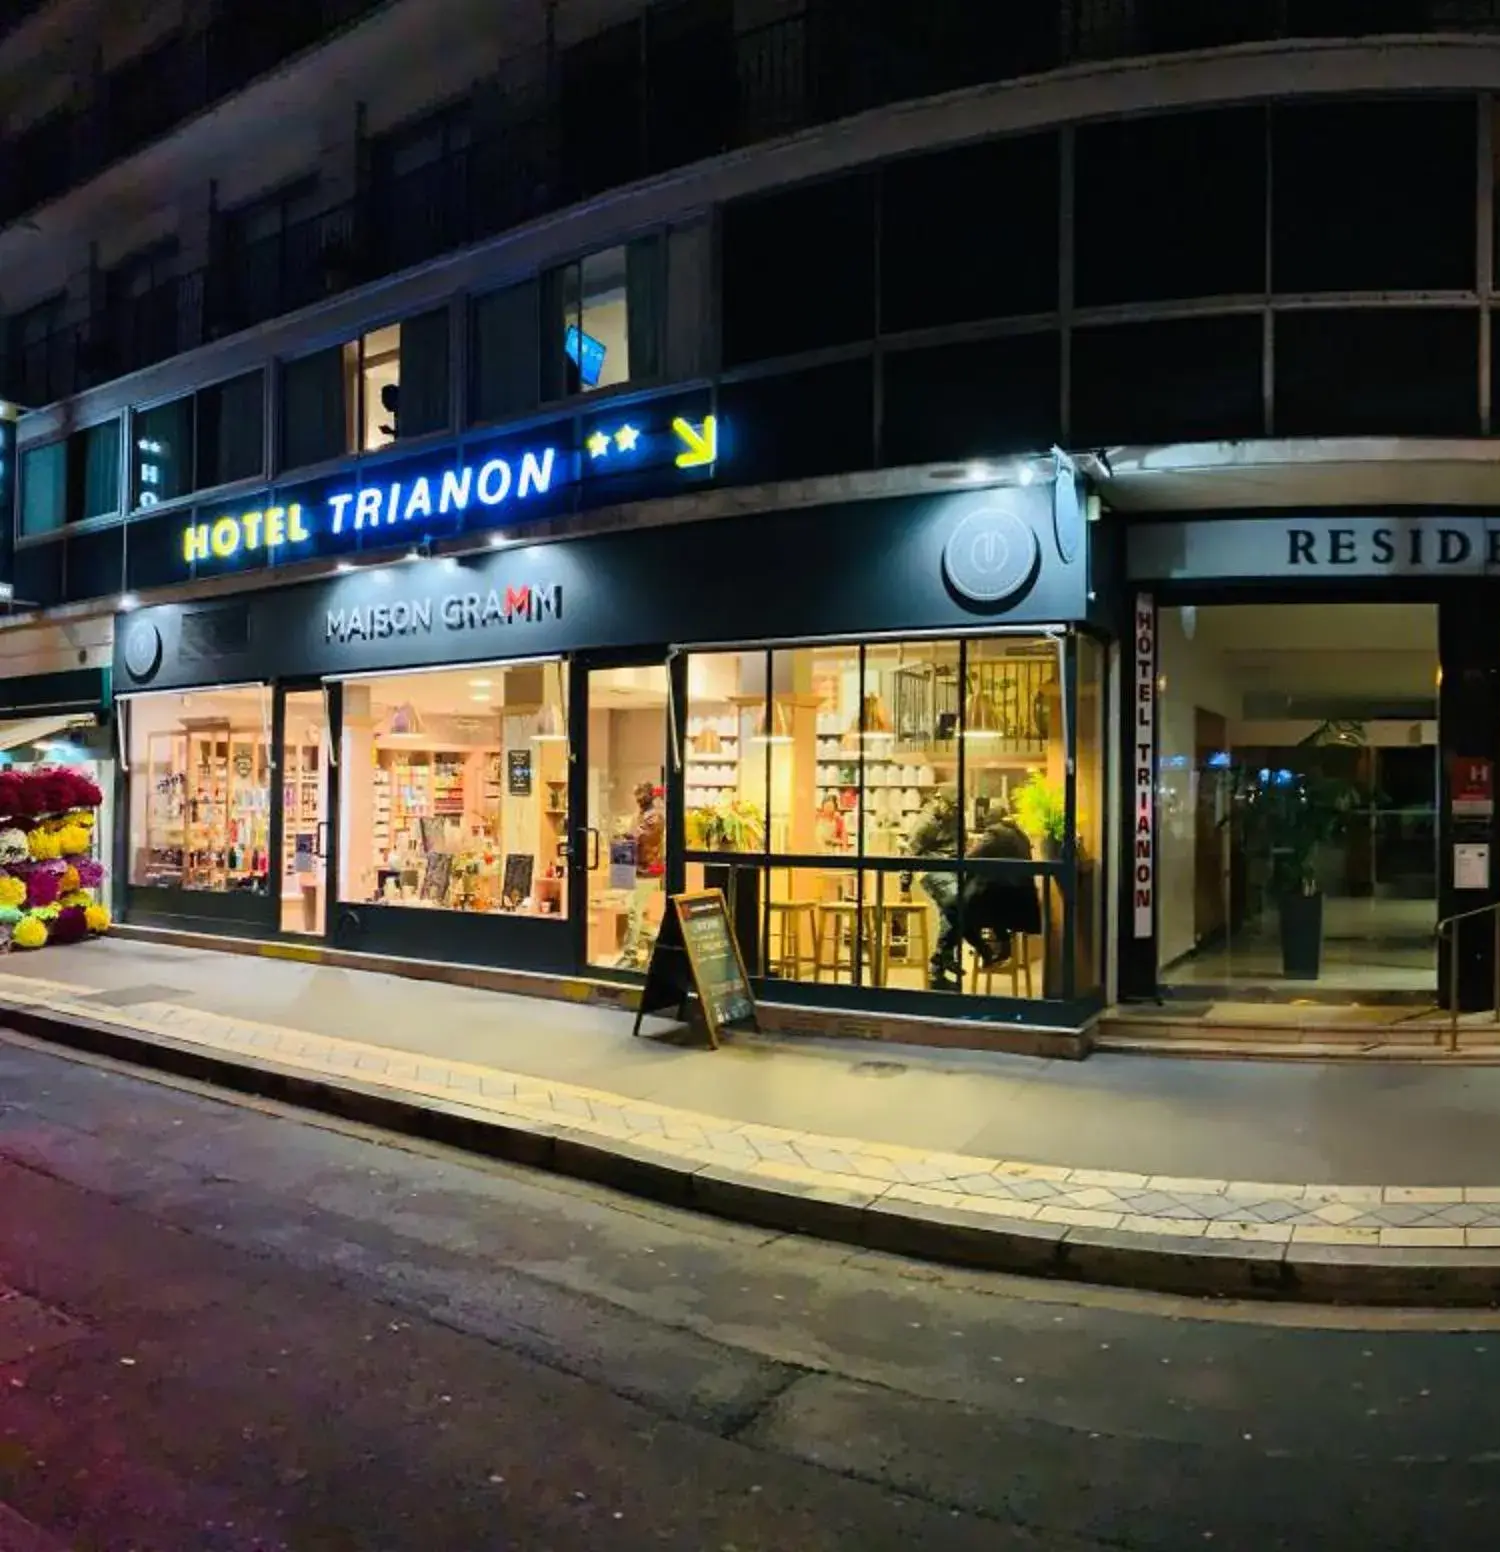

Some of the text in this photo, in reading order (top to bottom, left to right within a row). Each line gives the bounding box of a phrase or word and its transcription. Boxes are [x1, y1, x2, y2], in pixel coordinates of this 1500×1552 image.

[183, 447, 555, 562] HOTEL TRIANON
[325, 582, 560, 641] MAISON GRAMM
[1135, 611, 1151, 908] HOTEL TRIANON
[1470, 764, 1489, 782] H
